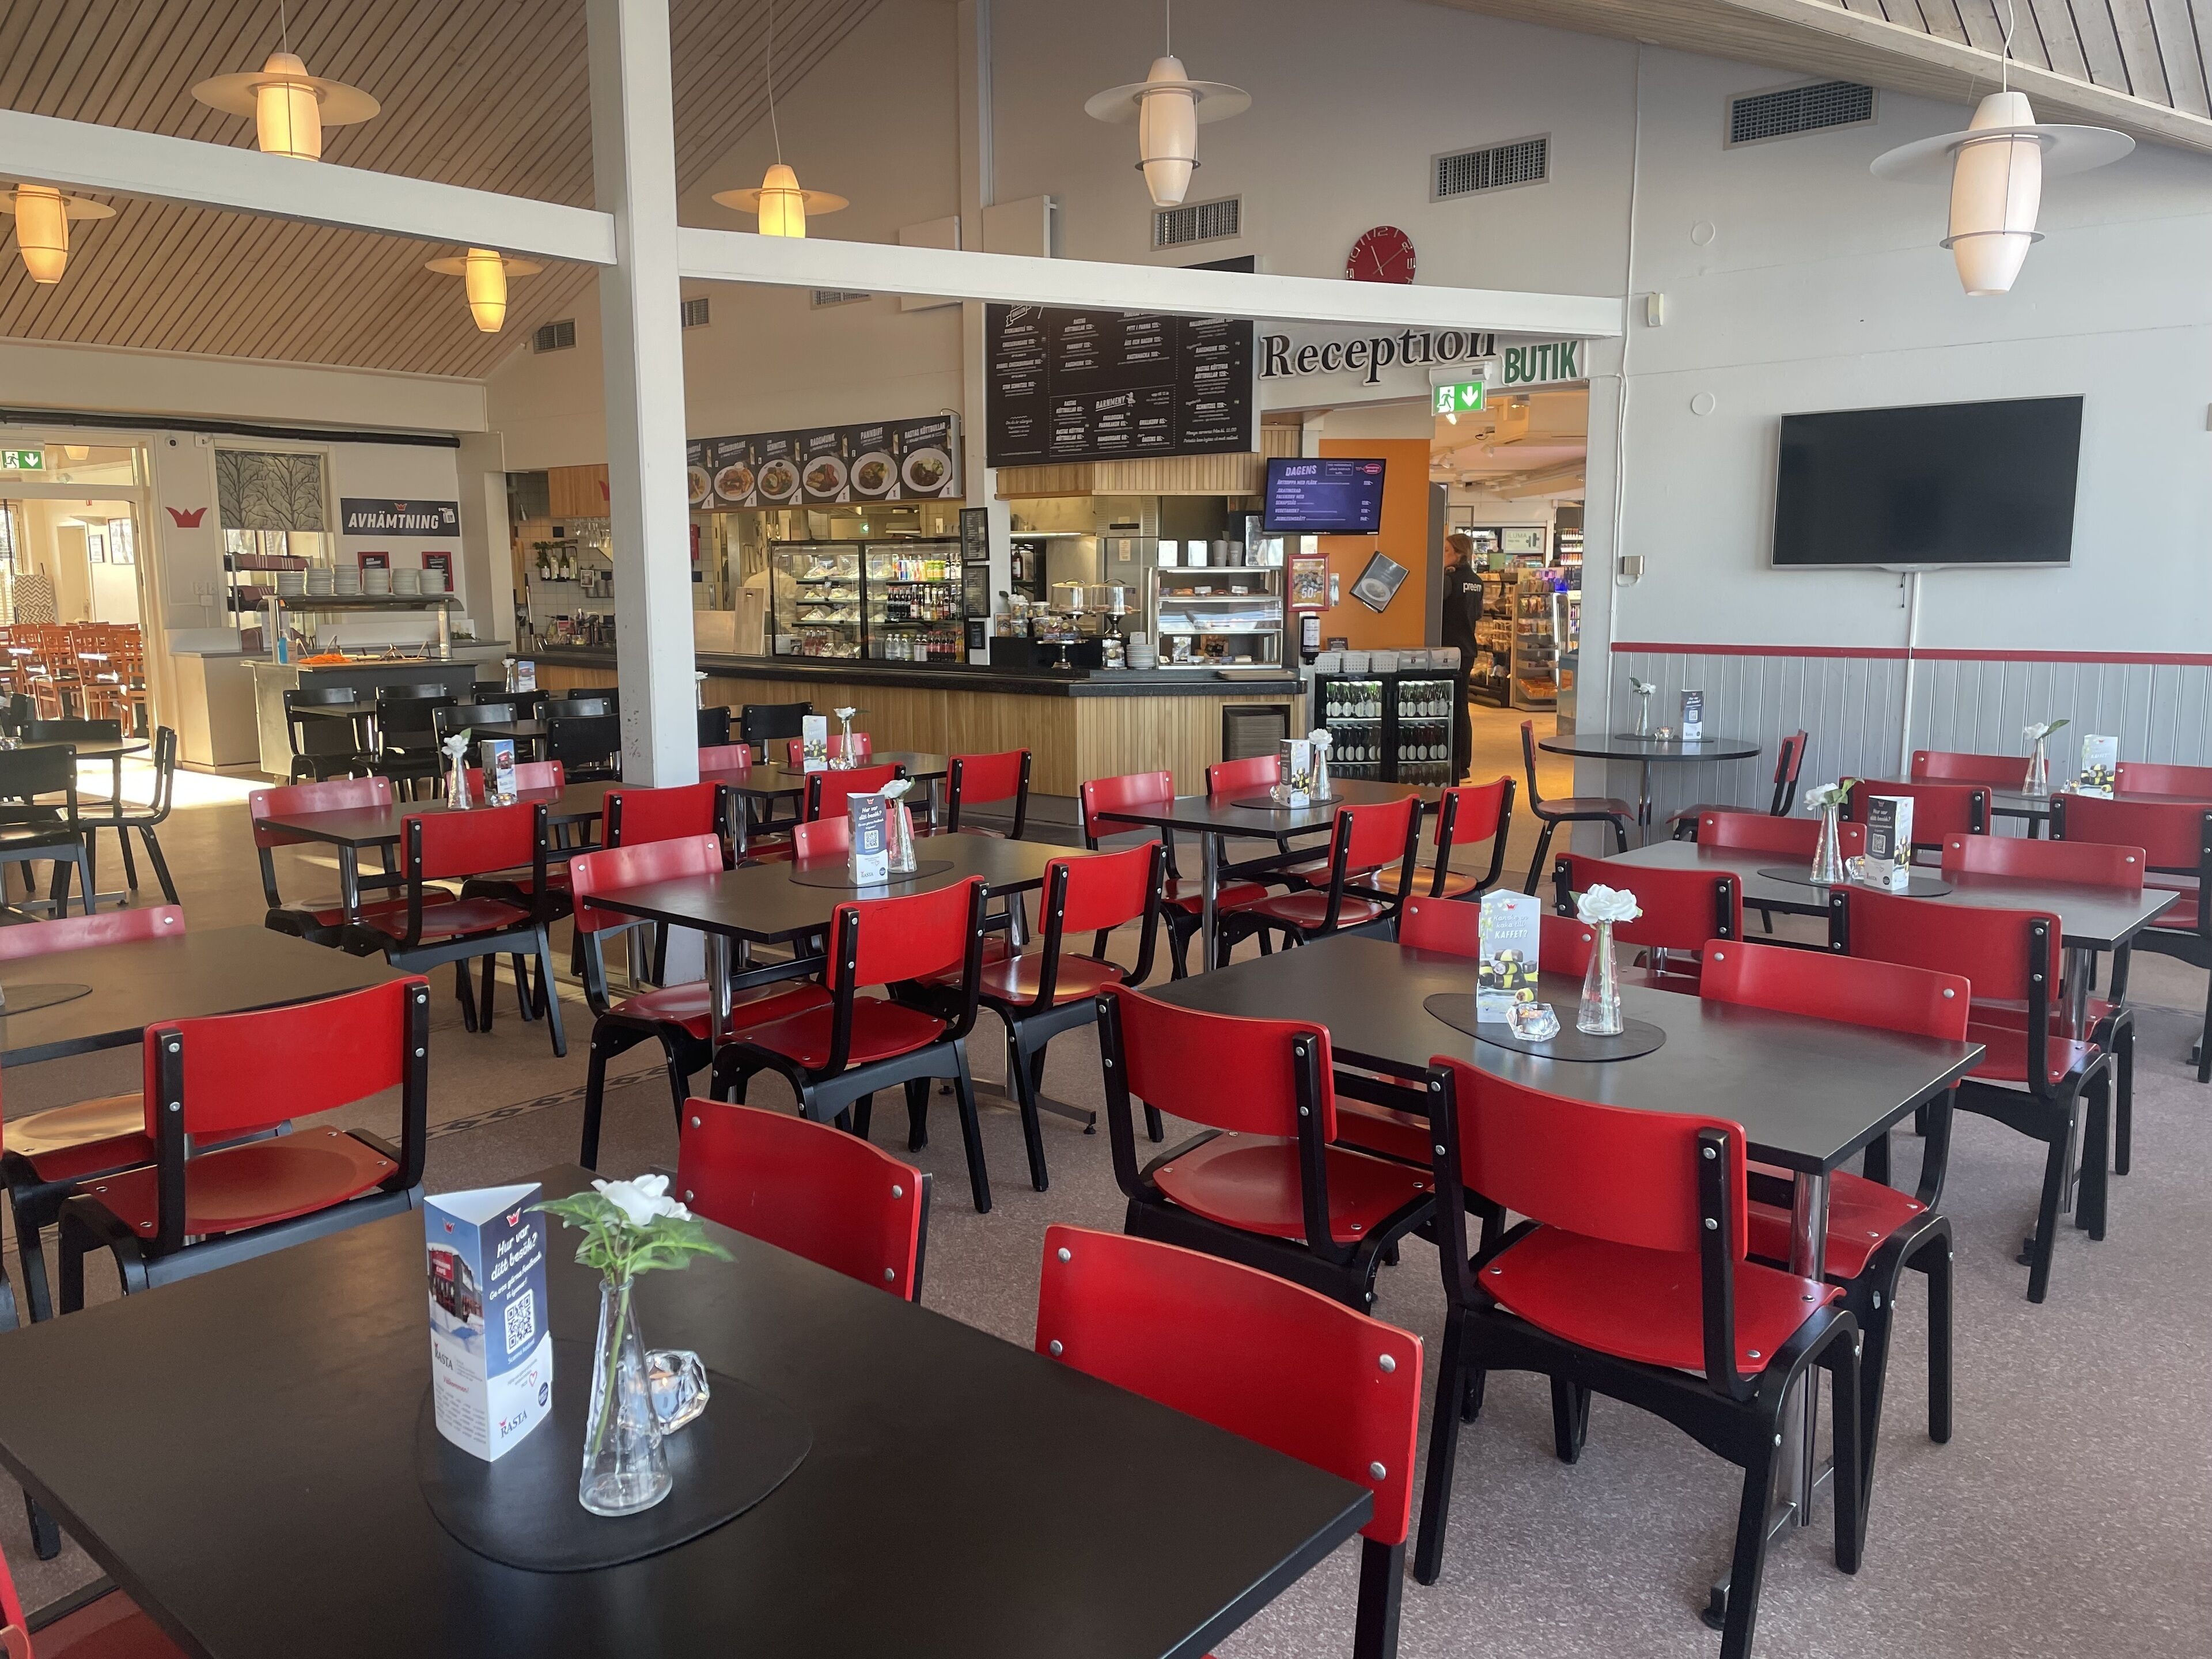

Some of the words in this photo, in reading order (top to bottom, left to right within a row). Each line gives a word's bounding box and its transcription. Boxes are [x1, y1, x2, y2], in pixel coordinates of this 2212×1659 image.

[1373, 227, 1388, 237] 12
[1262, 329, 1497, 385] Reception
[1504, 340, 1578, 384] BUTIK
[1096, 395, 1126, 410] BARNMENY
[1285, 465, 1317, 476] DAGENS
[348, 510, 439, 529] AVHÄMTNING
[1494, 930, 1528, 940] KAFFET?
[497, 1237, 514, 1258] Hur
[516, 1224, 530, 1243] var
[491, 1258, 509, 1281] ditt
[509, 1232, 538, 1266] besök?
[434, 1349, 453, 1370] RASTA
[501, 1409, 527, 1438] RASTA
